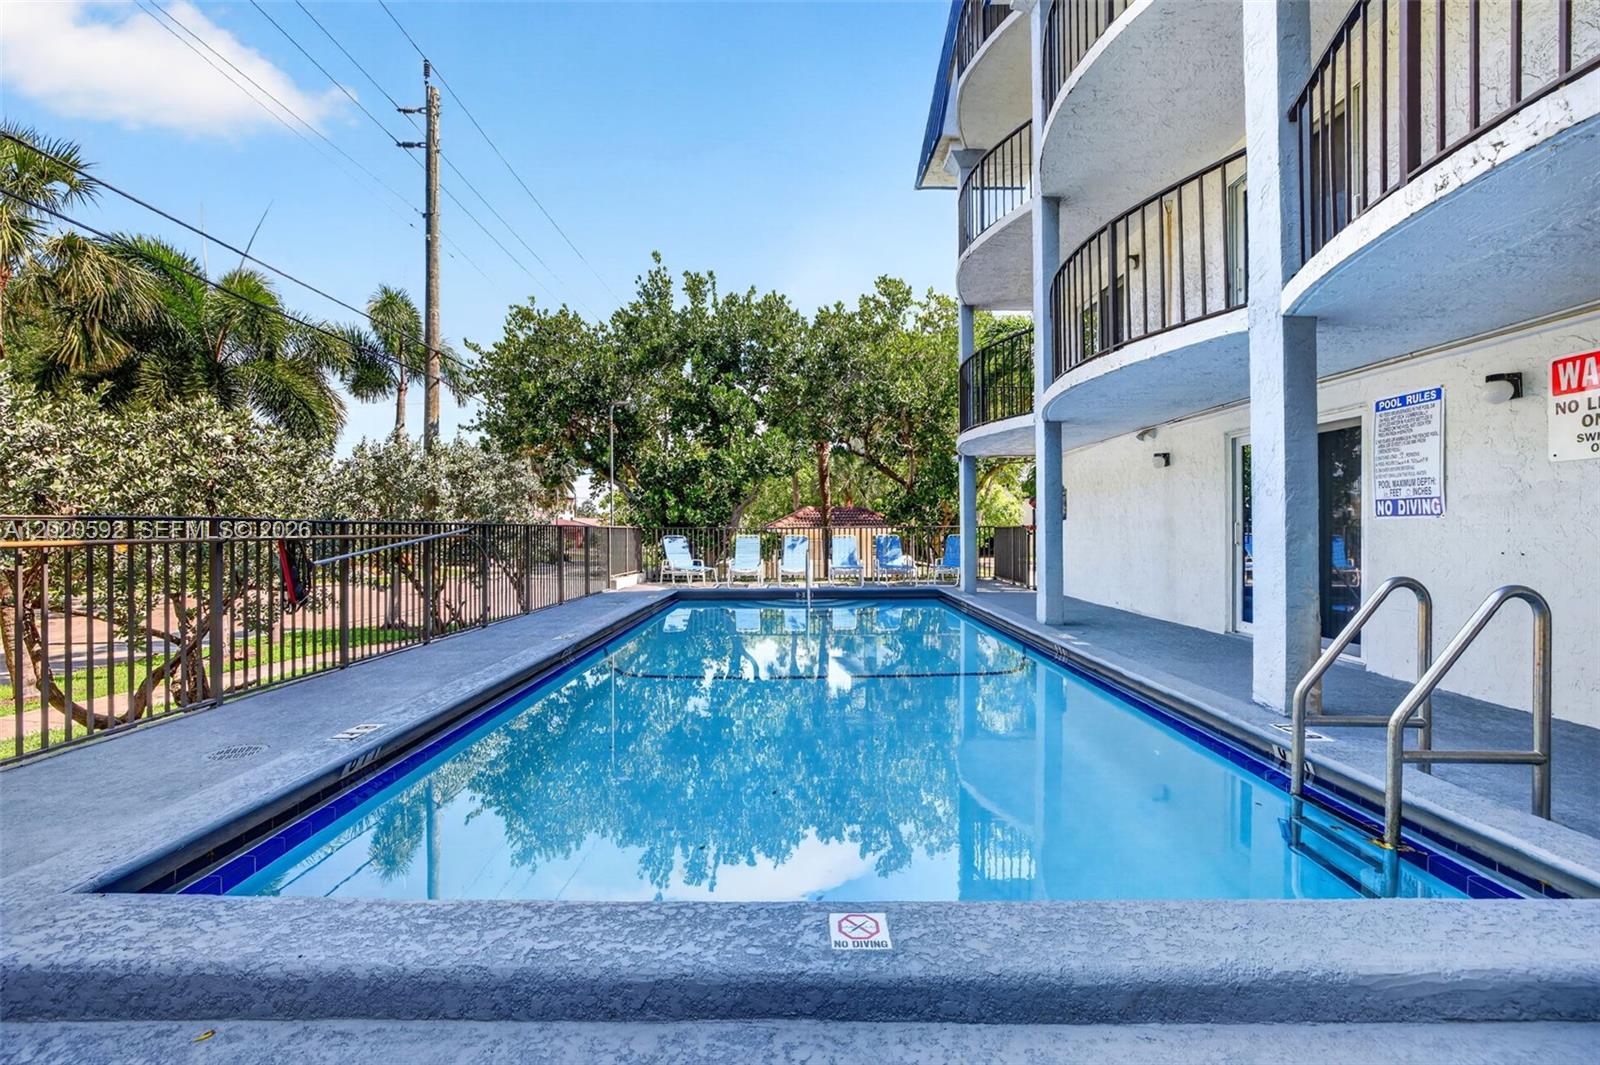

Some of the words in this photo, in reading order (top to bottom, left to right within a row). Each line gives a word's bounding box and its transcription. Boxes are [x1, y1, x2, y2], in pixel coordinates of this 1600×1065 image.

[1379, 397, 1402, 411] POOL
[1406, 390, 1437, 405] RULES
[1555, 399, 1580, 416] NO
[1376, 500, 1393, 516] NO
[1397, 498, 1442, 516] DIVING
[834, 940, 849, 948] NO
[852, 940, 888, 948] DIVING
